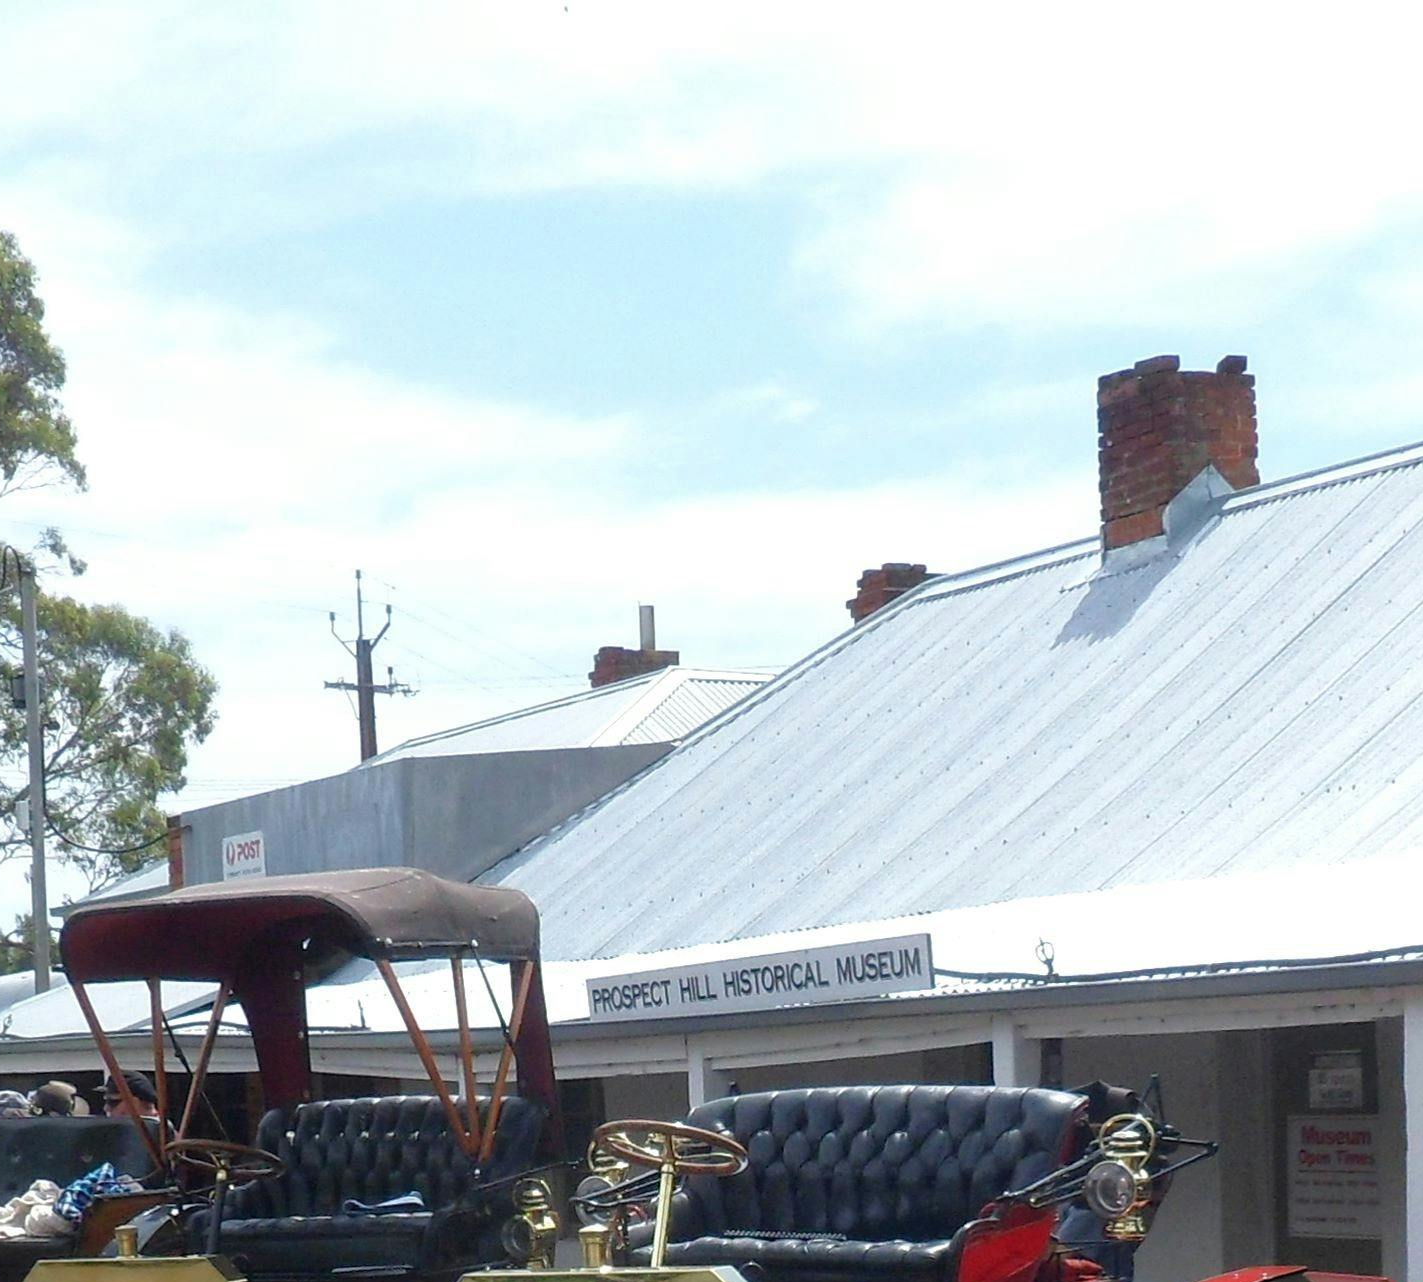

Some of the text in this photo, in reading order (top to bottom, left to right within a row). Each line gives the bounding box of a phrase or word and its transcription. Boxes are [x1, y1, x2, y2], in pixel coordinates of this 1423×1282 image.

[237, 839, 261, 861] POST
[592, 947, 922, 1014] PROSPECT HILL HISTORICAL MUSEUM
[1302, 1125, 1372, 1146] Museum
[1299, 1149, 1376, 1168] Open Times
